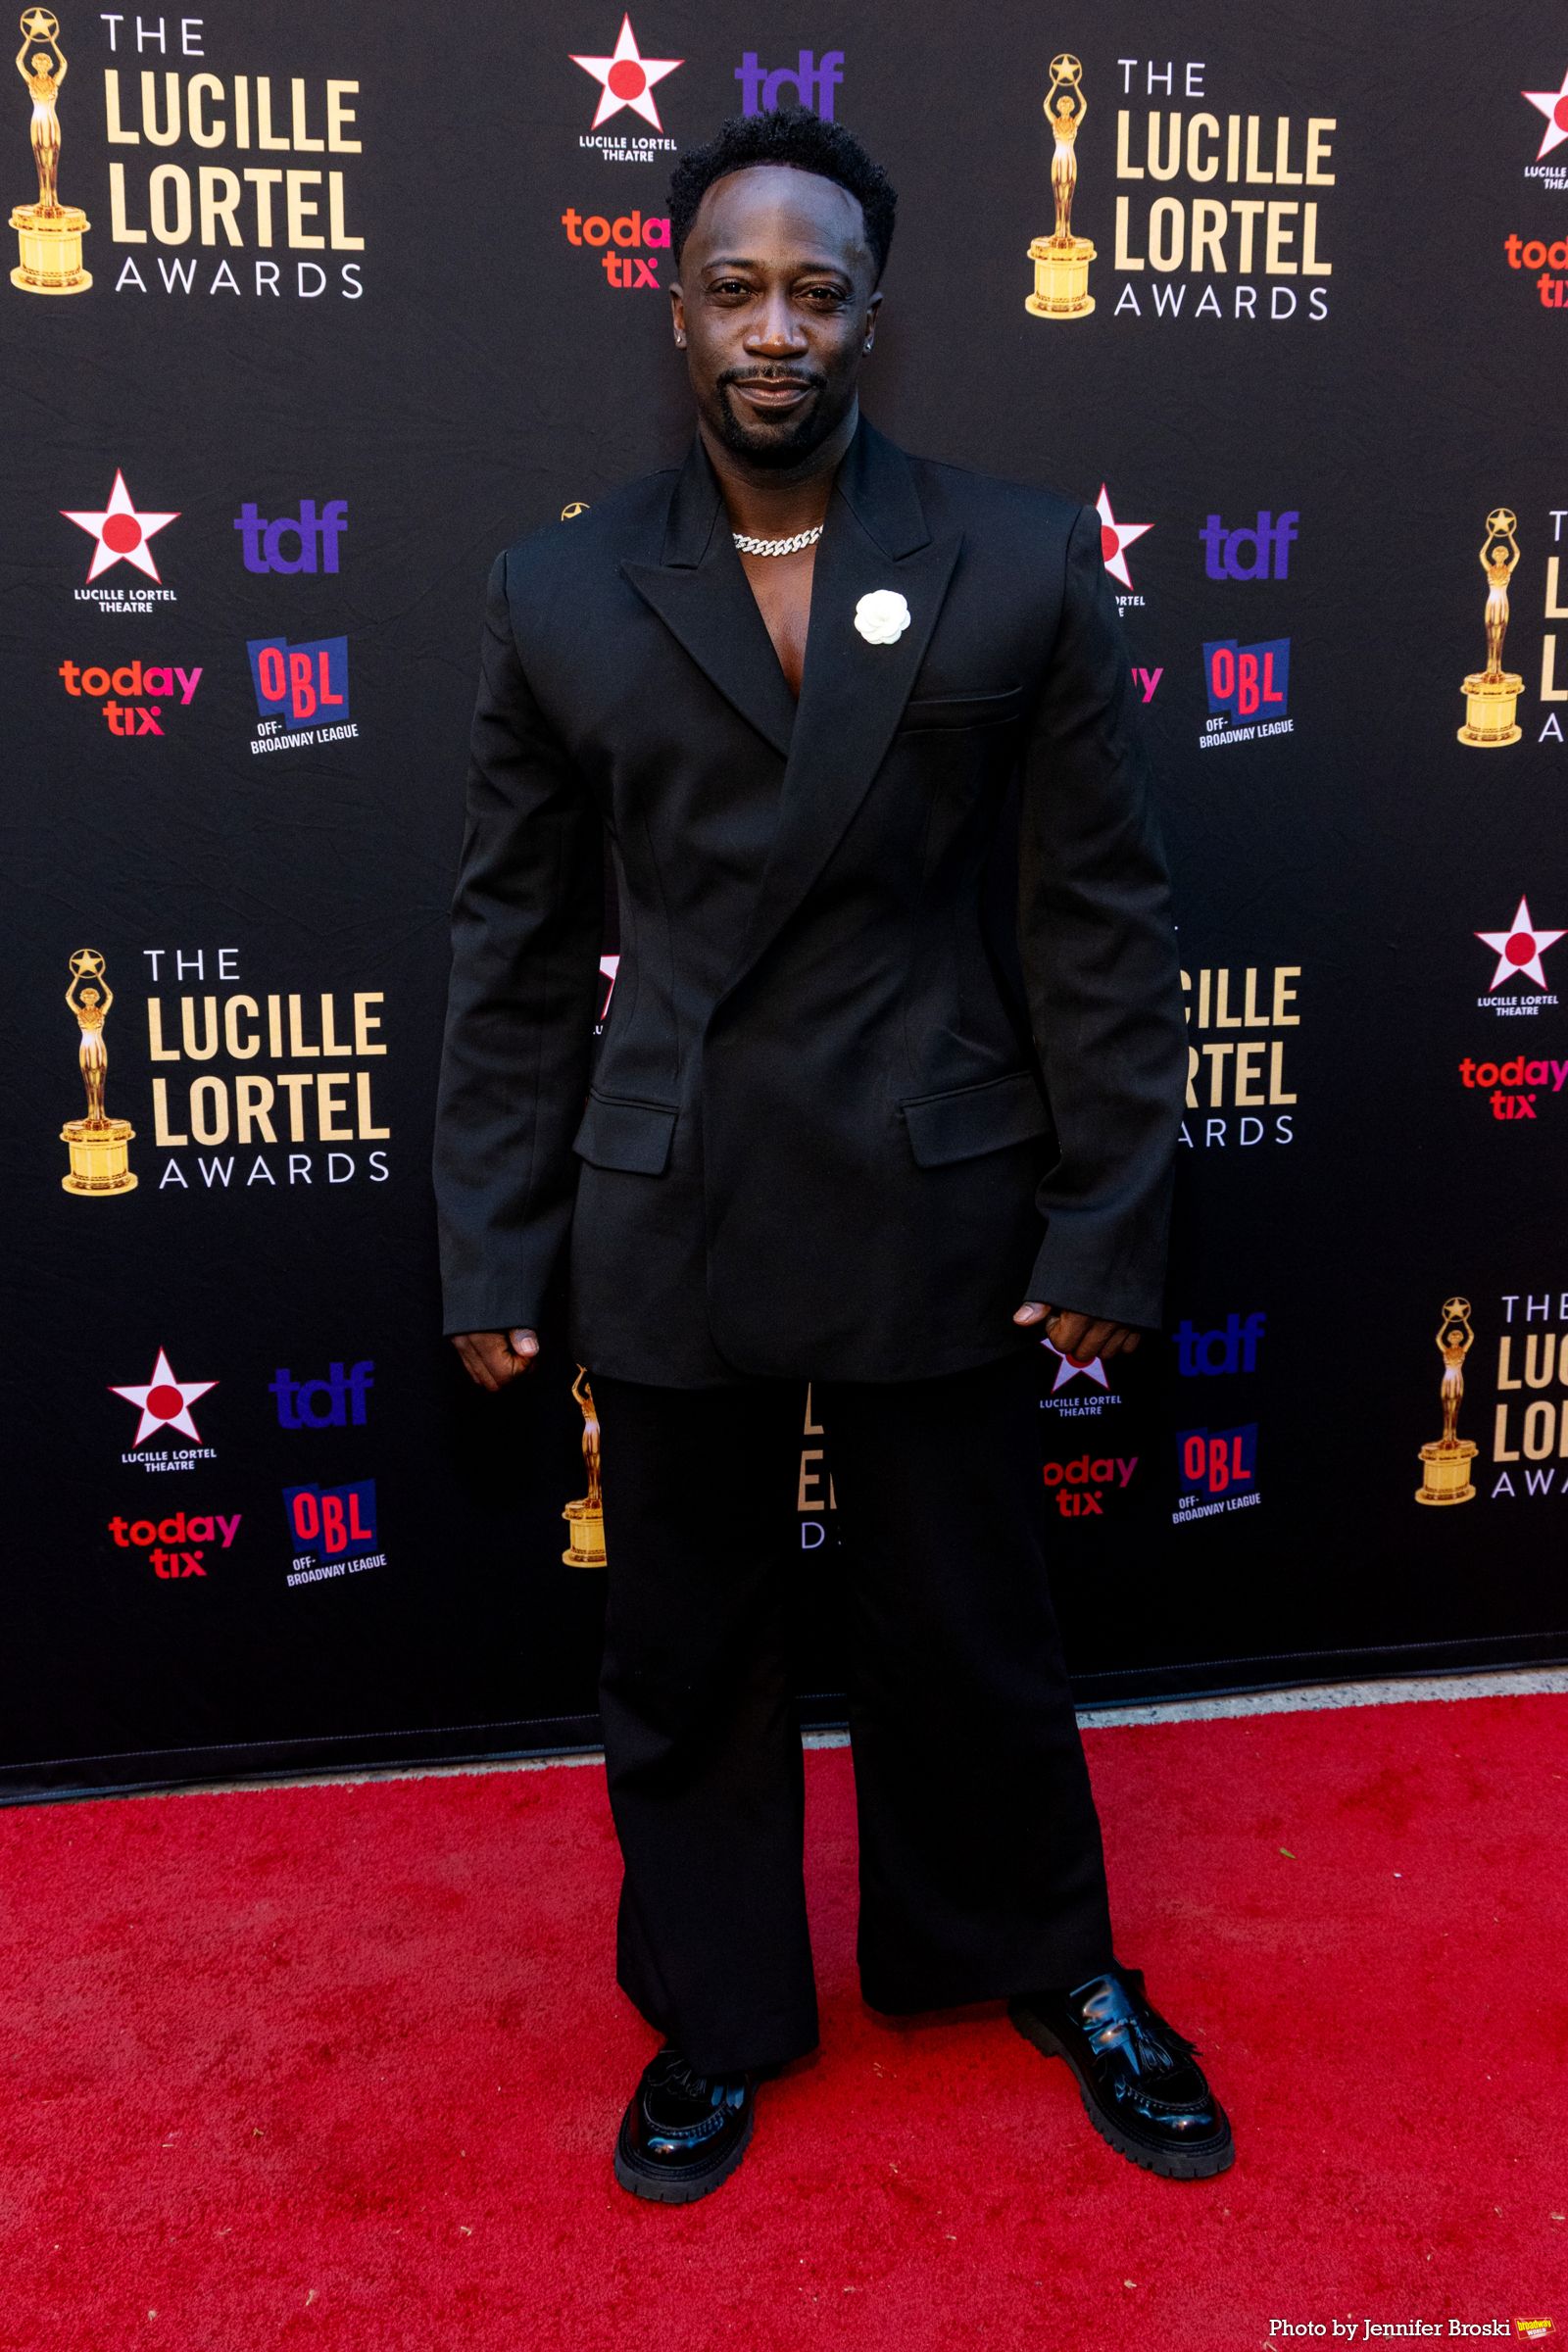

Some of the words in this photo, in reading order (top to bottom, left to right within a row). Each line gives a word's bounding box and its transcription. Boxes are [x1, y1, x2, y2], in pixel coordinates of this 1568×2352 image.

[100, 14, 204, 56] THE
[1117, 59, 1205, 97] THE
[105, 69, 362, 153] LUCILLE
[579, 135, 627, 148] LUCILLE
[632, 137, 677, 150] LORTEL
[603, 149, 654, 162] THEATRE
[1116, 110, 1337, 185] LUCILLE
[1524, 166, 1567, 177] LUCILLE
[109, 163, 365, 250] LORTEL
[562, 208, 670, 248] toda
[1114, 196, 1332, 275] LORTEL
[116, 257, 363, 299] AWARDS
[602, 250, 660, 289] tix
[1114, 282, 1328, 320] AWARDS
[233, 499, 348, 574] tdf
[1199, 511, 1299, 581] tdf
[74, 589, 124, 601] LUCILLE
[129, 590, 176, 601] LORTEL
[99, 602, 153, 612] THEATRE
[1115, 596, 1146, 606] RTEL
[59, 660, 203, 705] today
[258, 647, 343, 718] OBL
[1211, 648, 1283, 715] OBL
[102, 700, 165, 736] tix
[257, 721, 282, 737] OFF-
[1200, 726, 1255, 749] BROADWAY
[1257, 718, 1294, 738] LEAGUE
[1206, 716, 1228, 732] OFF-
[250, 728, 315, 755] BROADWAY
[317, 723, 359, 743] LEAGUE
[143, 949, 240, 981] THE
[1478, 997, 1518, 1007] LUCILLE
[1521, 995, 1558, 1005] LORTEL
[1495, 1006, 1539, 1016] THEATRE
[147, 992, 387, 1061] LUCILLE
[1458, 1055, 1568, 1092] today
[152, 1072, 391, 1147] LORTEL
[1490, 1090, 1537, 1120] tix
[1178, 1115, 1294, 1149] ARDS
[159, 1152, 389, 1190] AWARDS
[1172, 1312, 1266, 1377] tdf
[269, 1360, 375, 1430] tdf
[1040, 1397, 1080, 1409] LUCILLE
[1084, 1396, 1122, 1406] LORTEL
[1058, 1406, 1102, 1417] THEATRE
[122, 1451, 169, 1463] LUCILLE
[172, 1448, 217, 1460] LORTEL
[144, 1460, 195, 1472] THEATRE
[1043, 1454, 1139, 1488] oday
[1184, 1436, 1251, 1493] OBL
[1055, 1489, 1103, 1517] tix
[1172, 1502, 1225, 1525] BROADWAY
[1227, 1493, 1261, 1512] LEAGUE
[1179, 1495, 1200, 1509] OFF-
[109, 1512, 242, 1548] today
[292, 1492, 372, 1553] OBL
[150, 1547, 207, 1580] tix
[287, 1564, 346, 1587] BROADWAY
[348, 1554, 387, 1574] LEAGUE
[293, 1555, 317, 1571] OFF-
